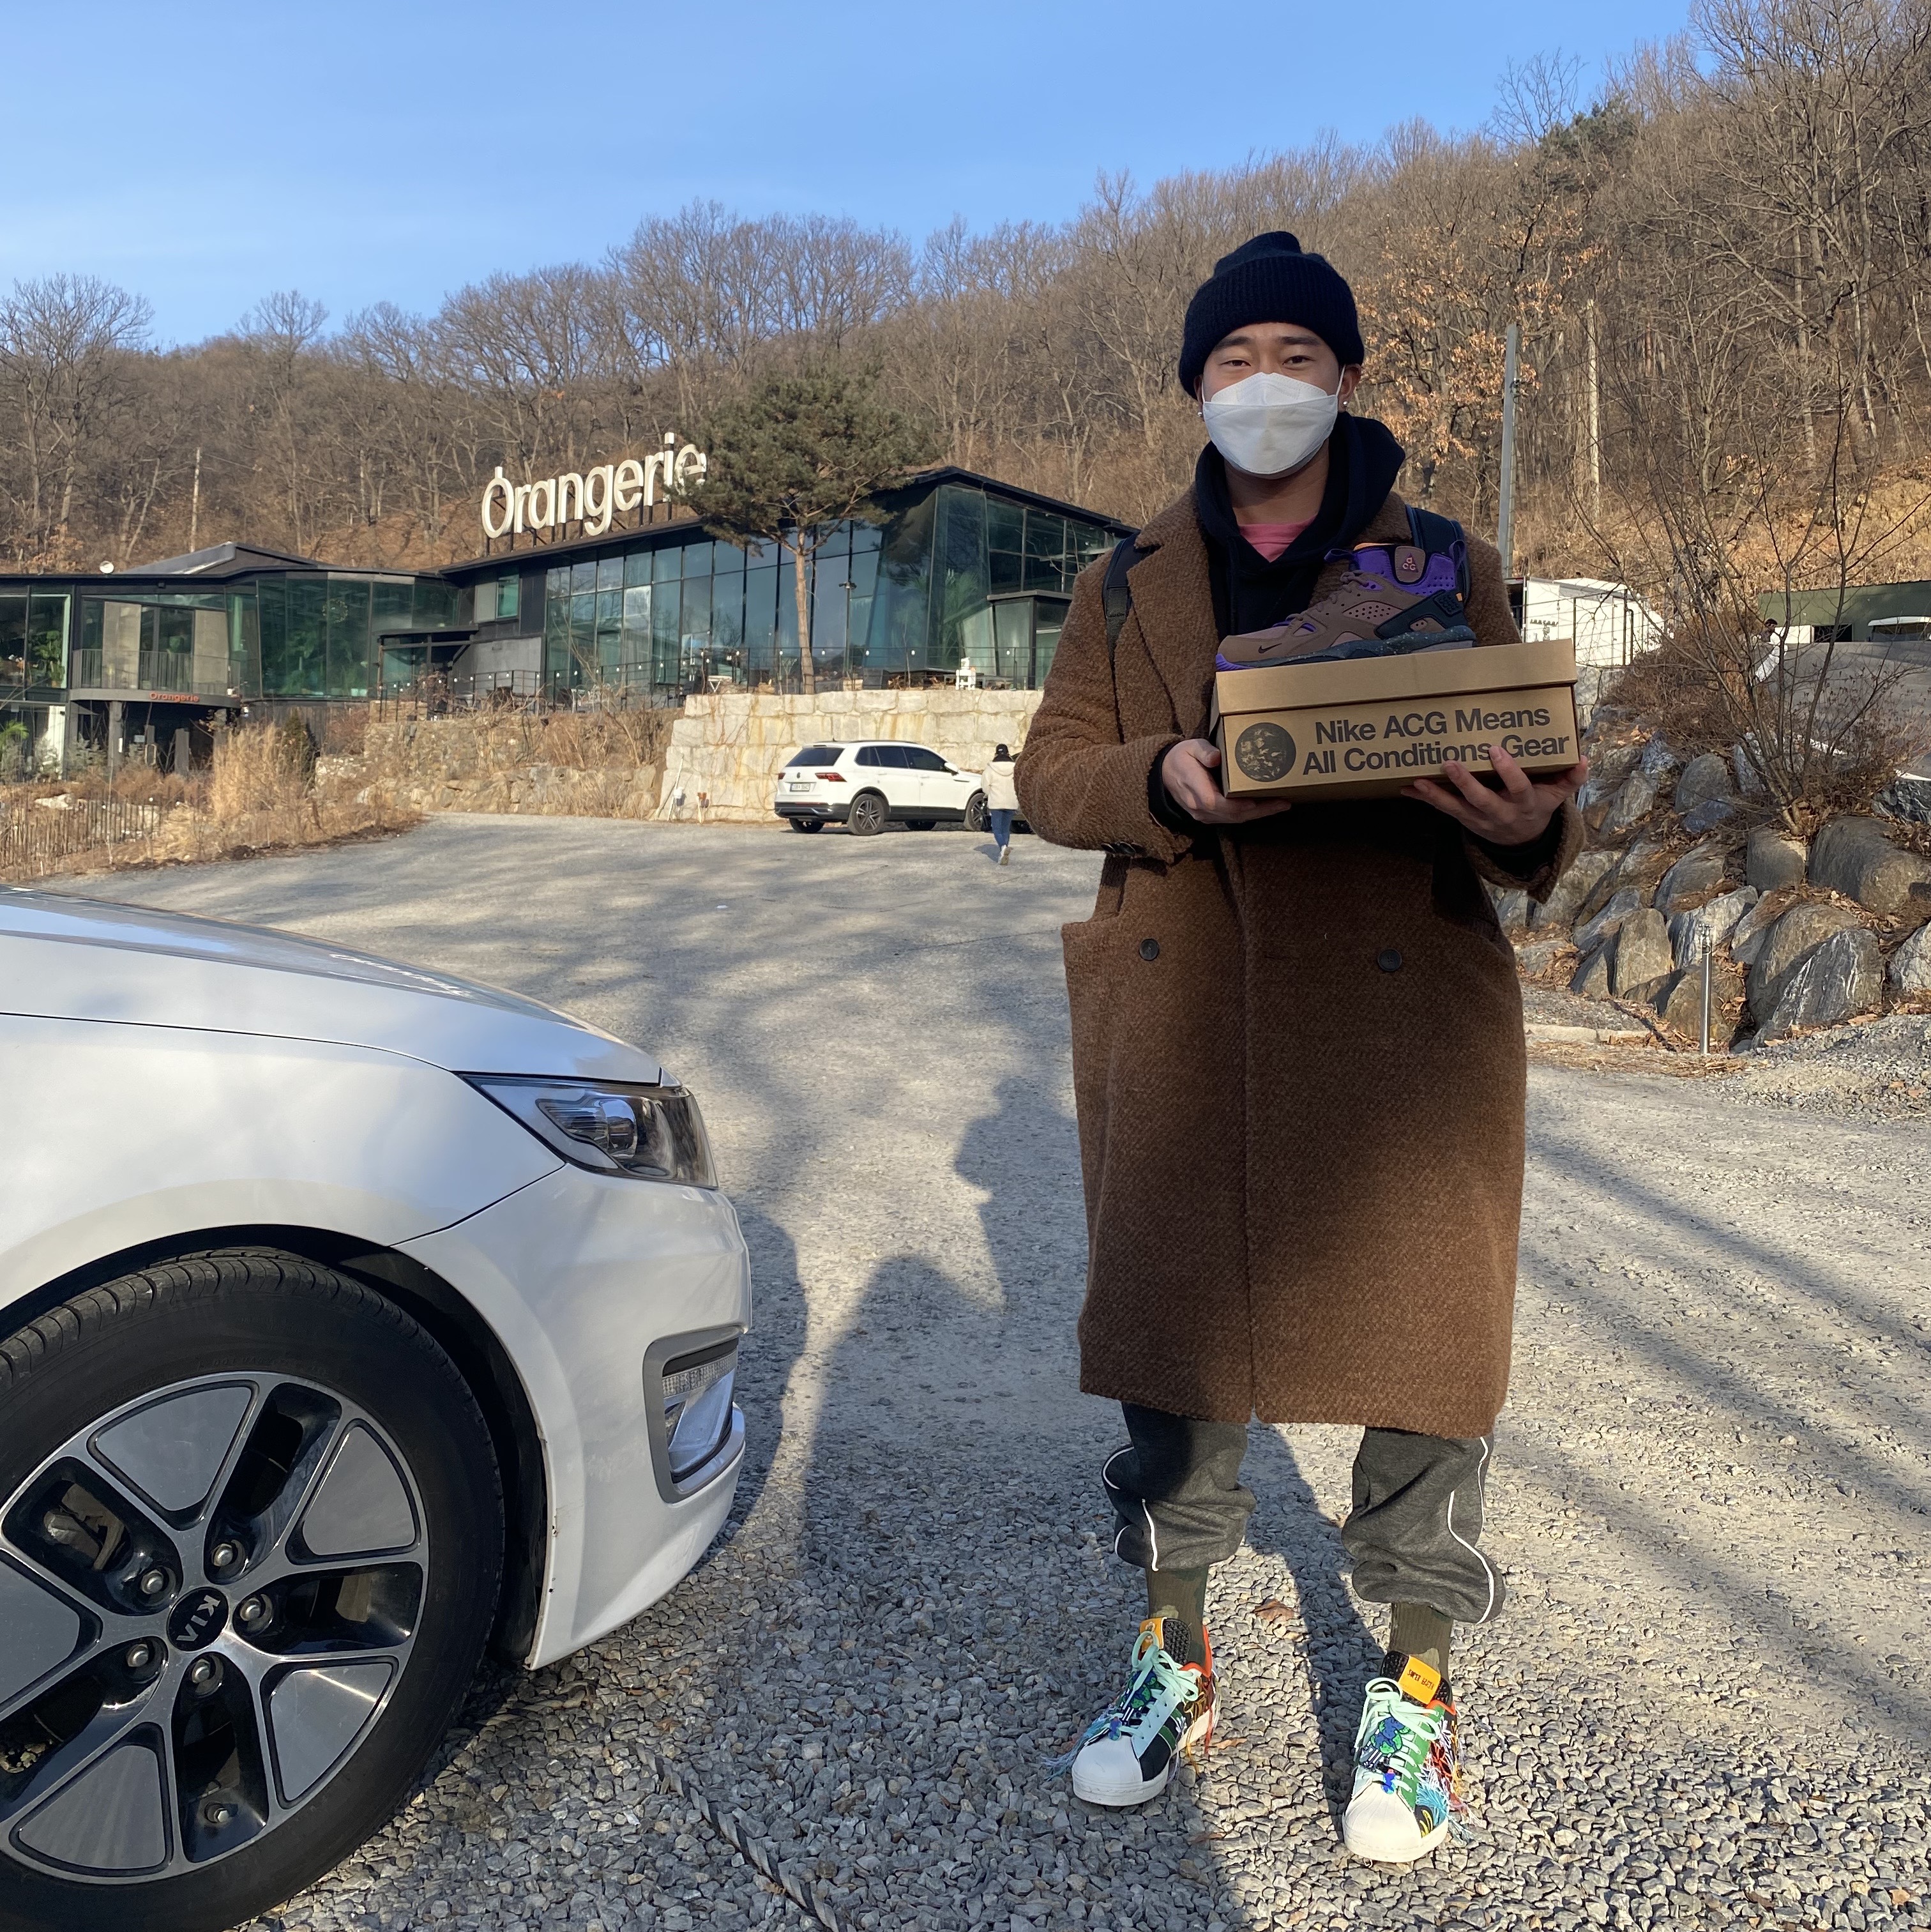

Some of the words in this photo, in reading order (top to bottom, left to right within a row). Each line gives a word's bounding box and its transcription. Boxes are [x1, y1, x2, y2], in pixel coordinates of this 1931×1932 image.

[149, 692, 200, 703] Orangerie
[1315, 719, 1376, 745] Nike
[1383, 711, 1447, 739] ACG
[1455, 708, 1550, 733] Means
[1303, 750, 1337, 775] All
[1344, 740, 1492, 772] Conditions
[1501, 734, 1570, 758] Gear
[176, 1595, 221, 1641] KIA
